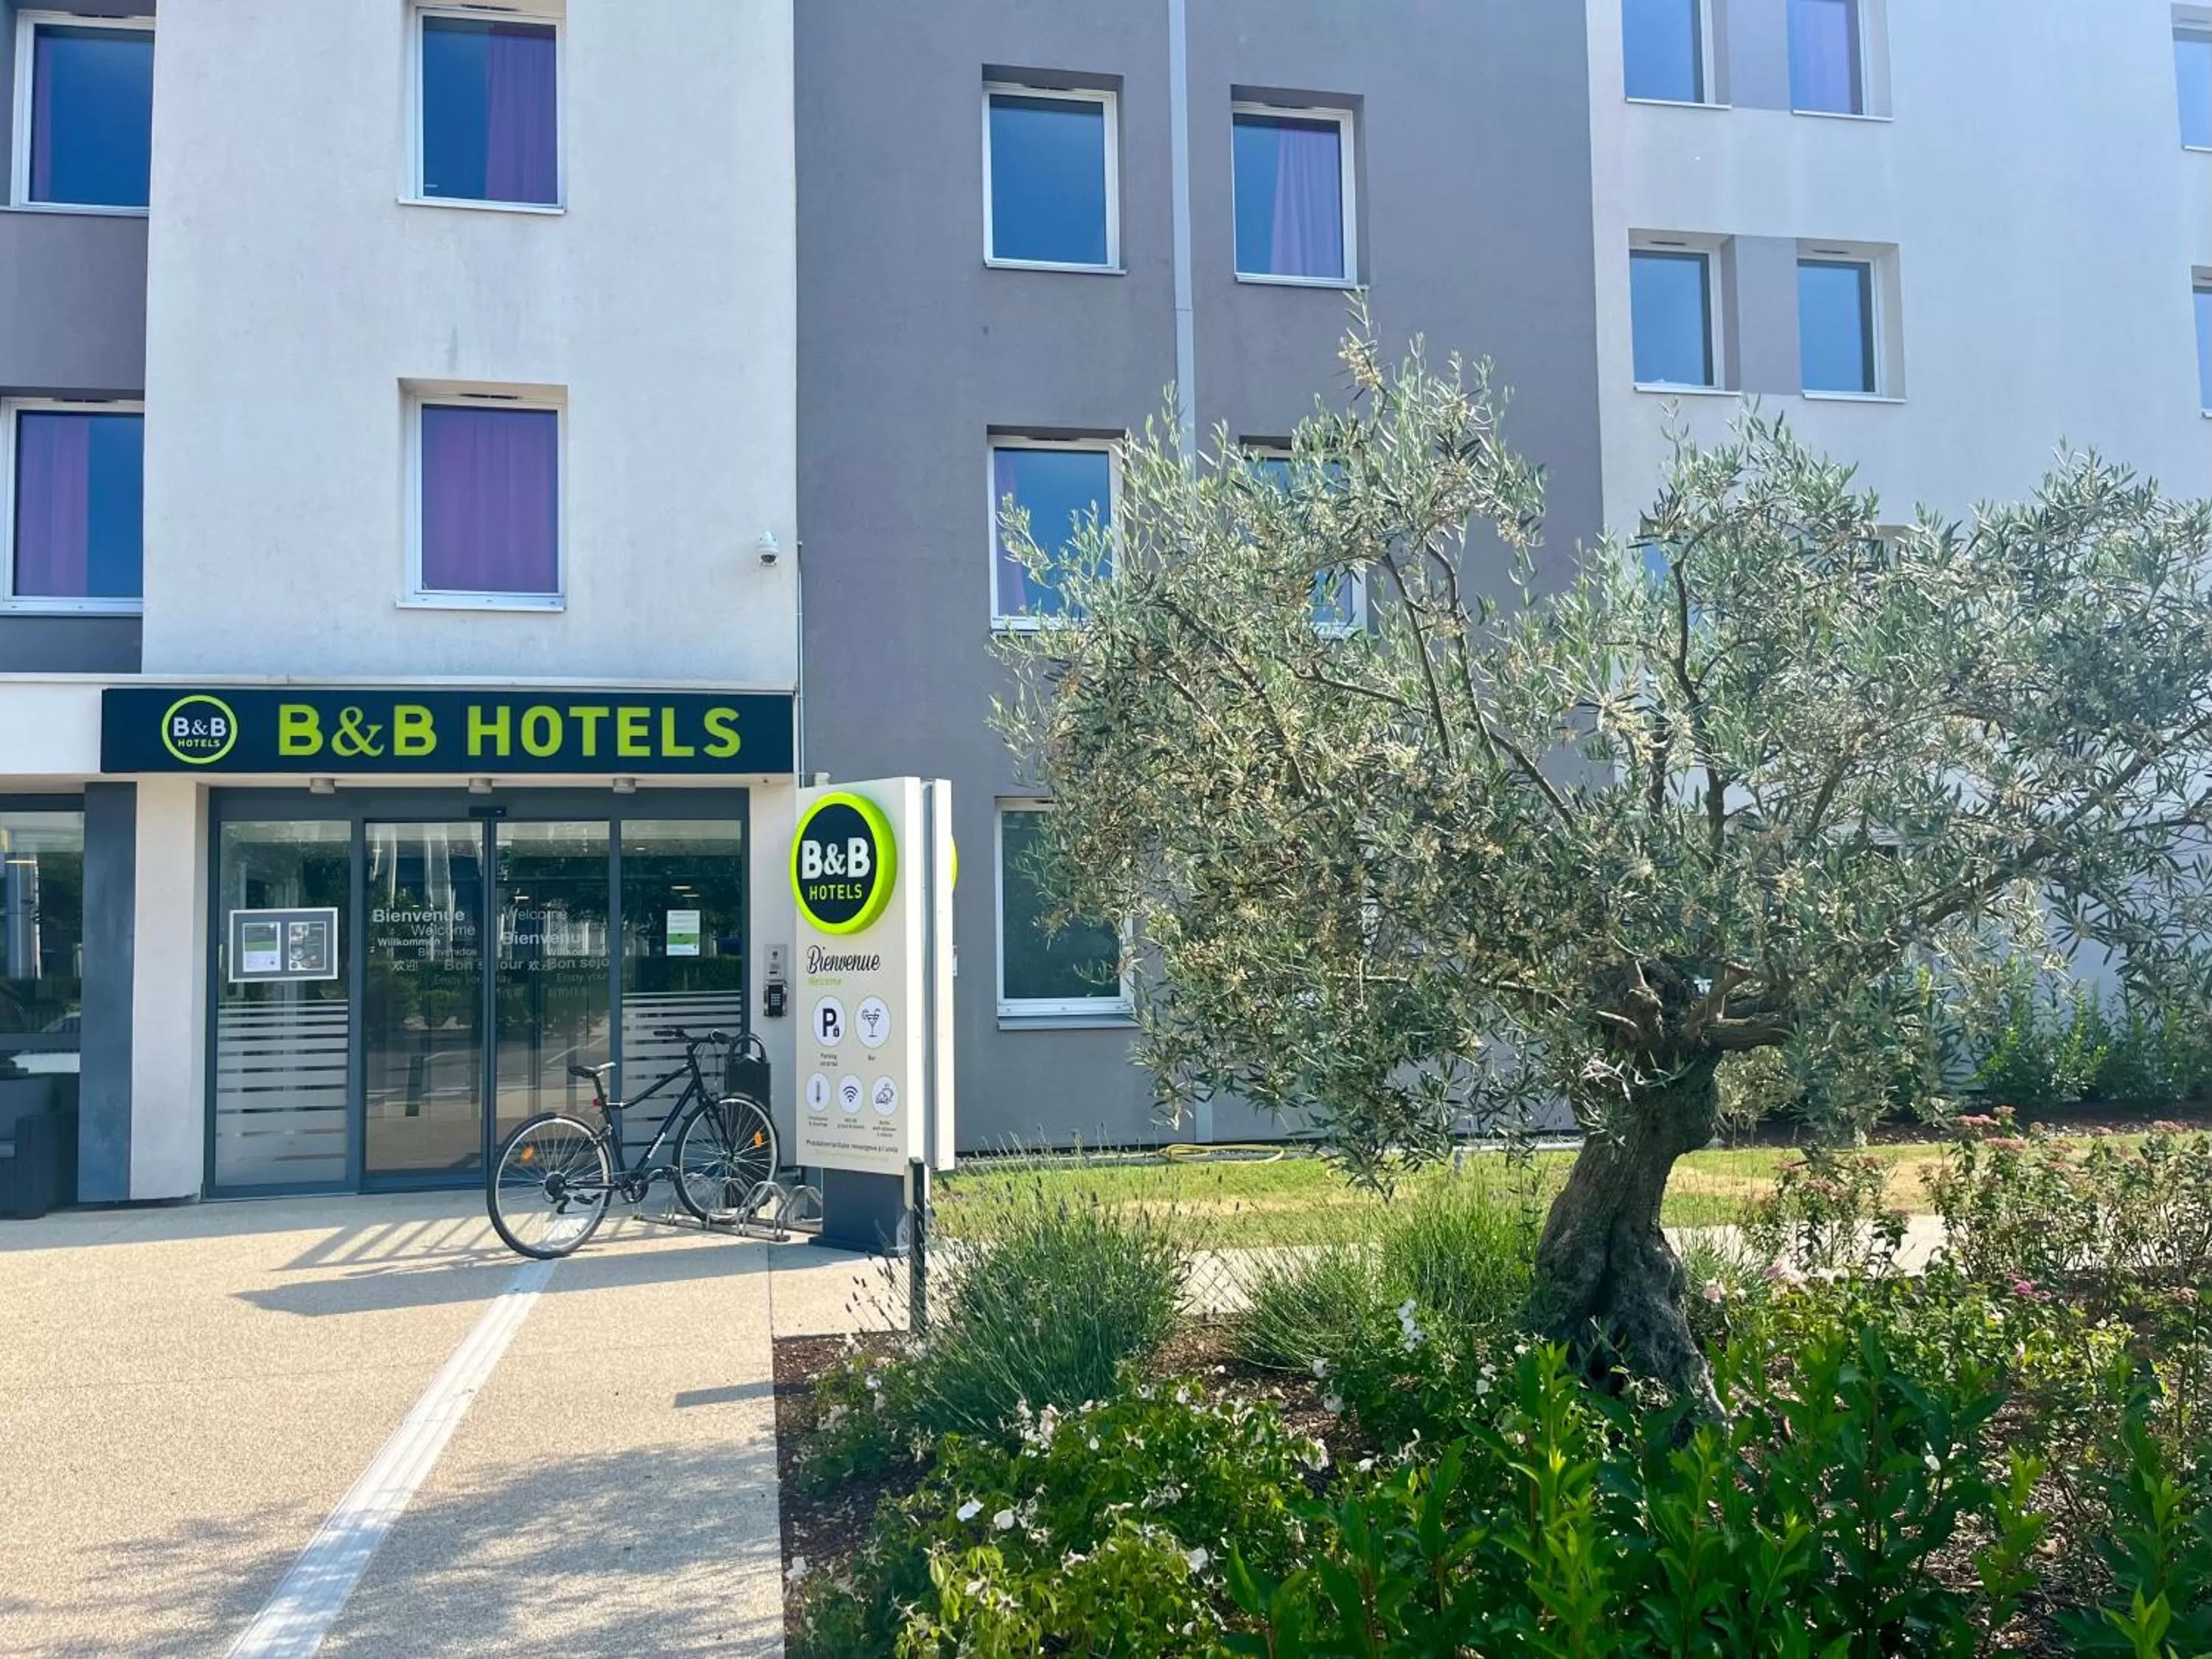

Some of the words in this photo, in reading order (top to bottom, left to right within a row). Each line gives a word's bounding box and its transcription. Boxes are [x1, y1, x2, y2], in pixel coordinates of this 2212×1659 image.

[173, 717, 226, 737] B&B
[279, 704, 437, 757] B&B
[467, 706, 741, 758] HOTELS
[178, 739, 220, 747] HOTELS
[801, 838, 870, 880] B&B
[810, 884, 863, 900] HOTELS
[372, 909, 465, 922] Bienvenue
[411, 924, 476, 936] Welcome
[378, 937, 440, 946] Willkommen
[502, 932, 589, 945] Bienvenu
[444, 959, 473, 970] Bon
[477, 959, 524, 970] sjour
[549, 958, 576, 969] Bon
[807, 945, 881, 974] Bienvenue
